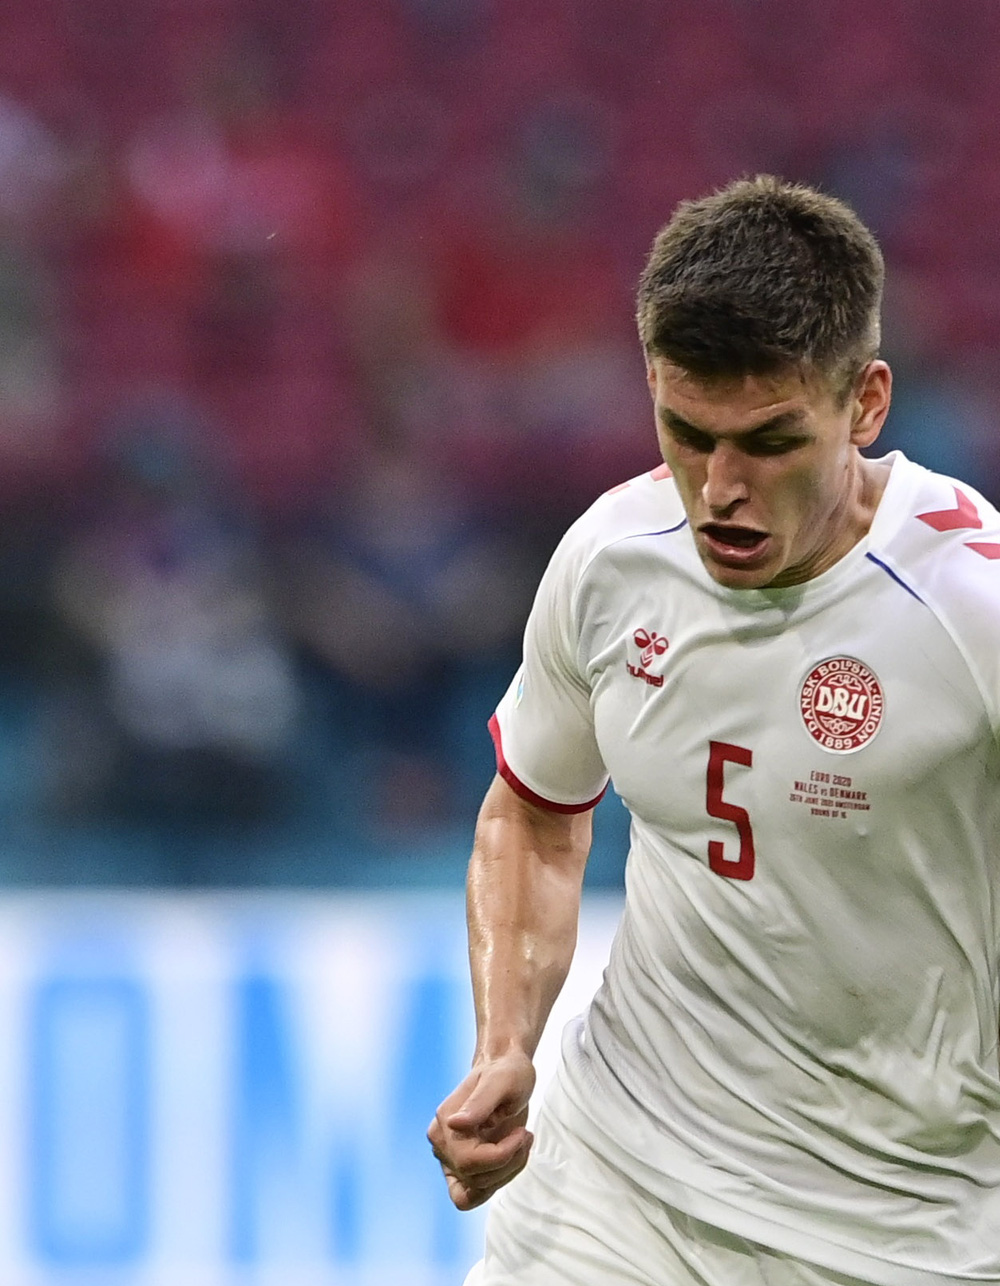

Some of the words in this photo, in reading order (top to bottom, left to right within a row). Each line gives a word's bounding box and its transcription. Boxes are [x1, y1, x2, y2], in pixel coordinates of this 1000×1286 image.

[801, 676, 820, 732] DANSK
[856, 694, 882, 743] UNION
[815, 685, 868, 721] DBU
[819, 733, 853, 749] 1889
[794, 780, 818, 795] WALES
[829, 787, 867, 801] DENMARK
[810, 770, 830, 784] EURO
[833, 774, 852, 787] 2020
[706, 740, 755, 881] 5
